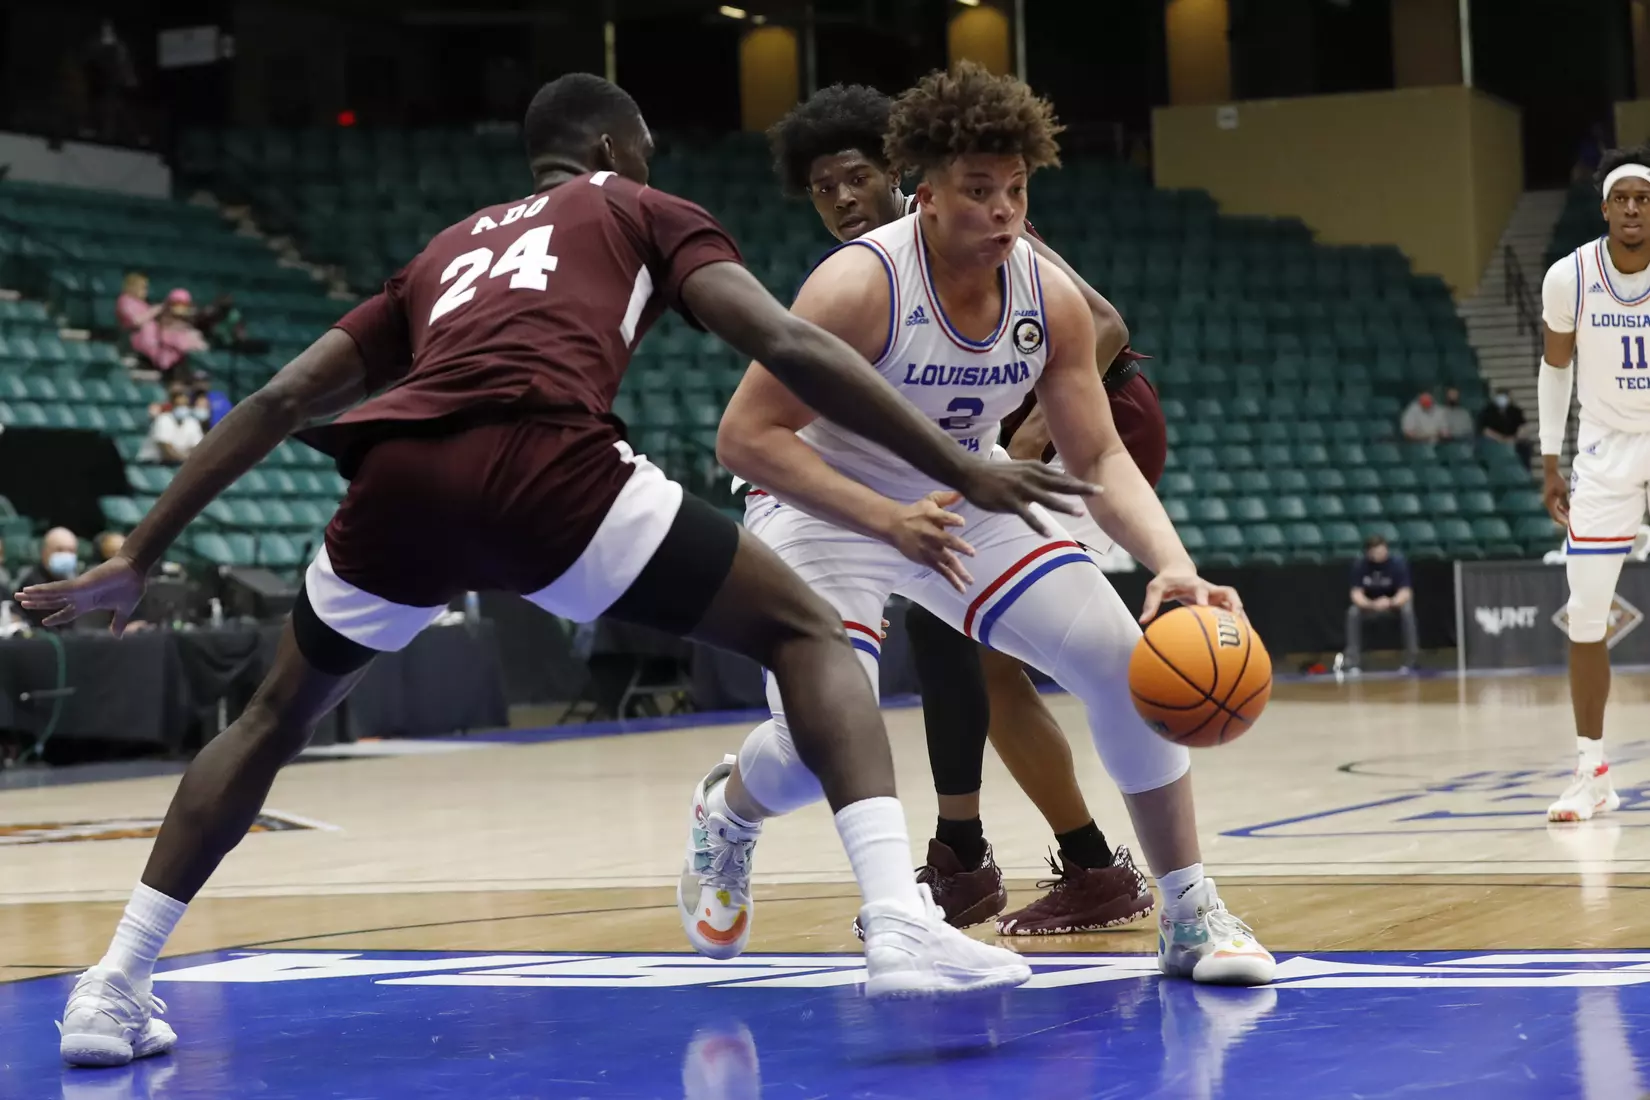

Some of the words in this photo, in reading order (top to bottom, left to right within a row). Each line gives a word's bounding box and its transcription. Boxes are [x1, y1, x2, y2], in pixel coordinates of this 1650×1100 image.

[470, 195, 550, 235] ADO
[428, 224, 558, 326] 24
[1621, 335, 1648, 369] 11
[903, 361, 1030, 386] LOUISIANA
[939, 397, 985, 430] 2
